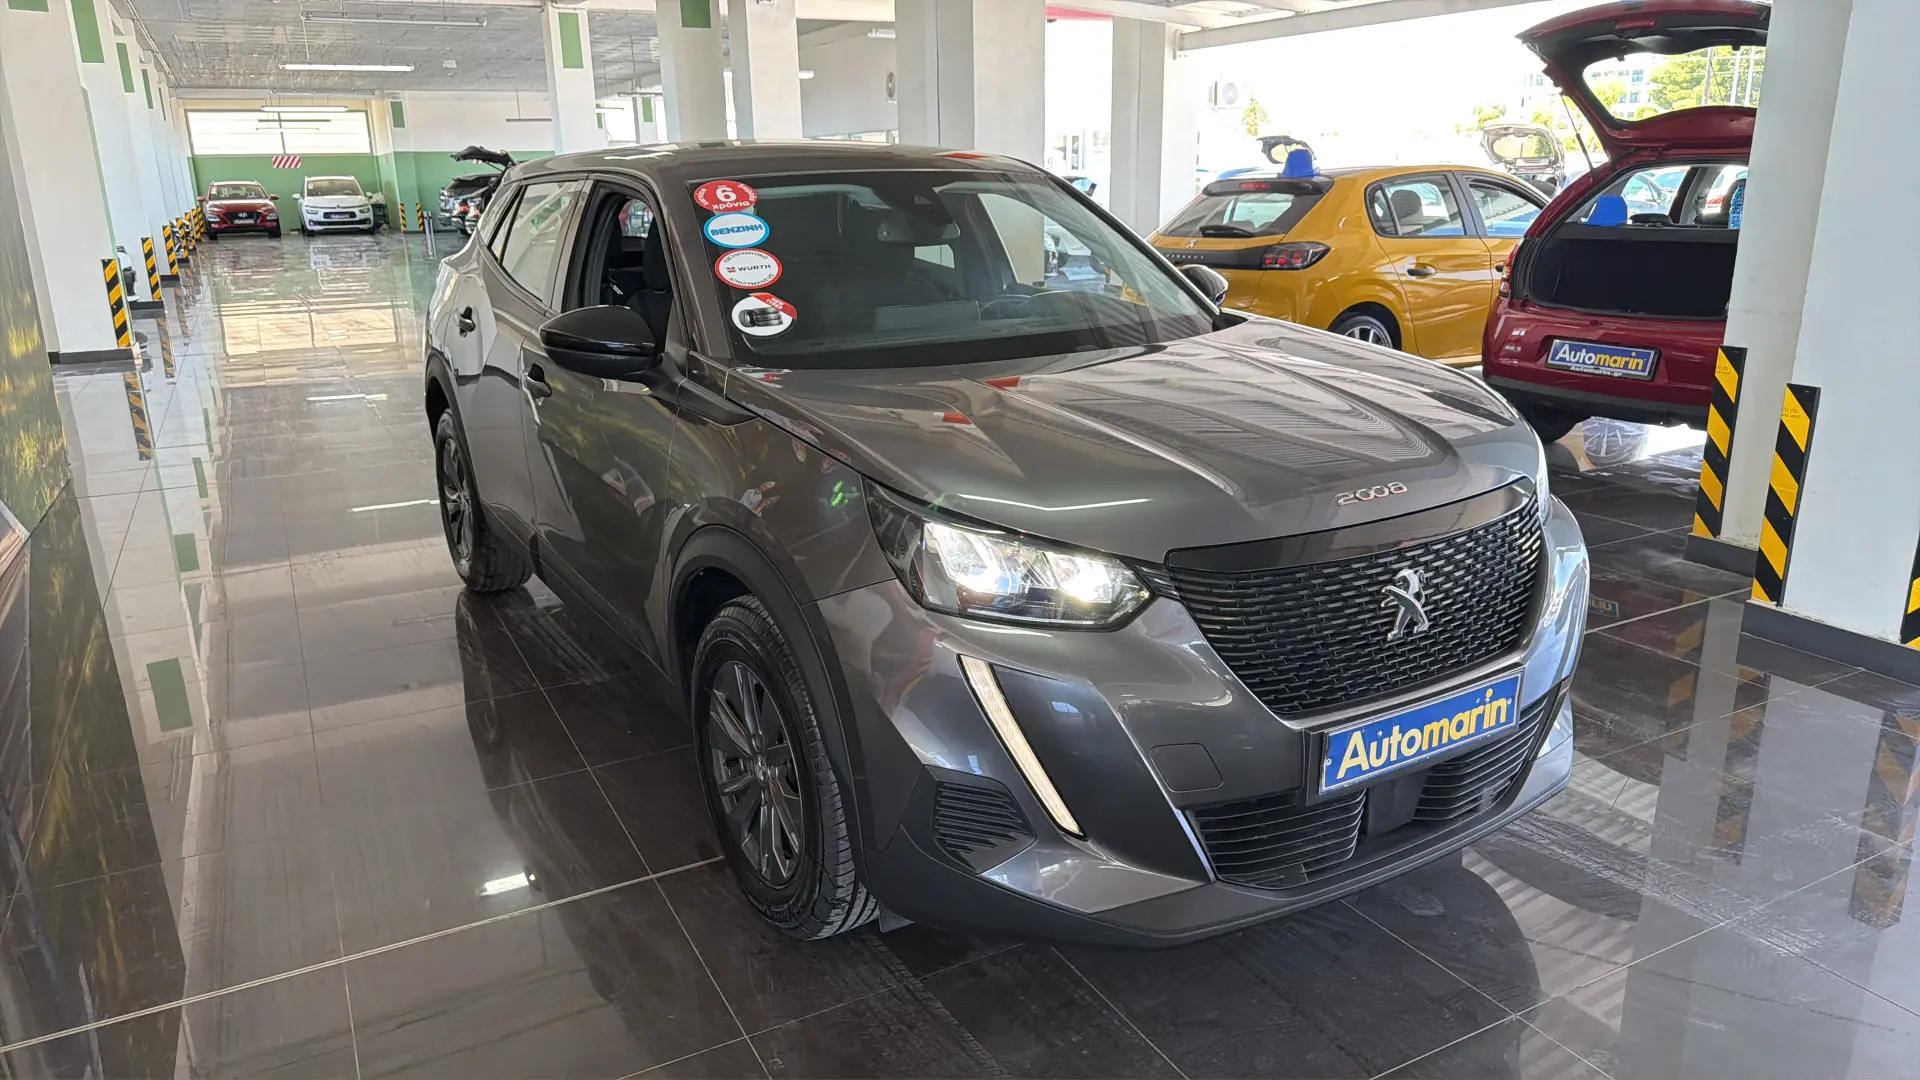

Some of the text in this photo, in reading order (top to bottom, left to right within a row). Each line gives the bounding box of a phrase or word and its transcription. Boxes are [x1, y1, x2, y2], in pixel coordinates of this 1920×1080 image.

[715, 186, 737, 203] 6
[711, 200, 751, 211] χρόνια
[1555, 343, 1645, 371] Automarin
[1570, 365, 1623, 377] Automarin.gr
[1334, 481, 1408, 506] 2008
[1336, 687, 1507, 780] Automarin
